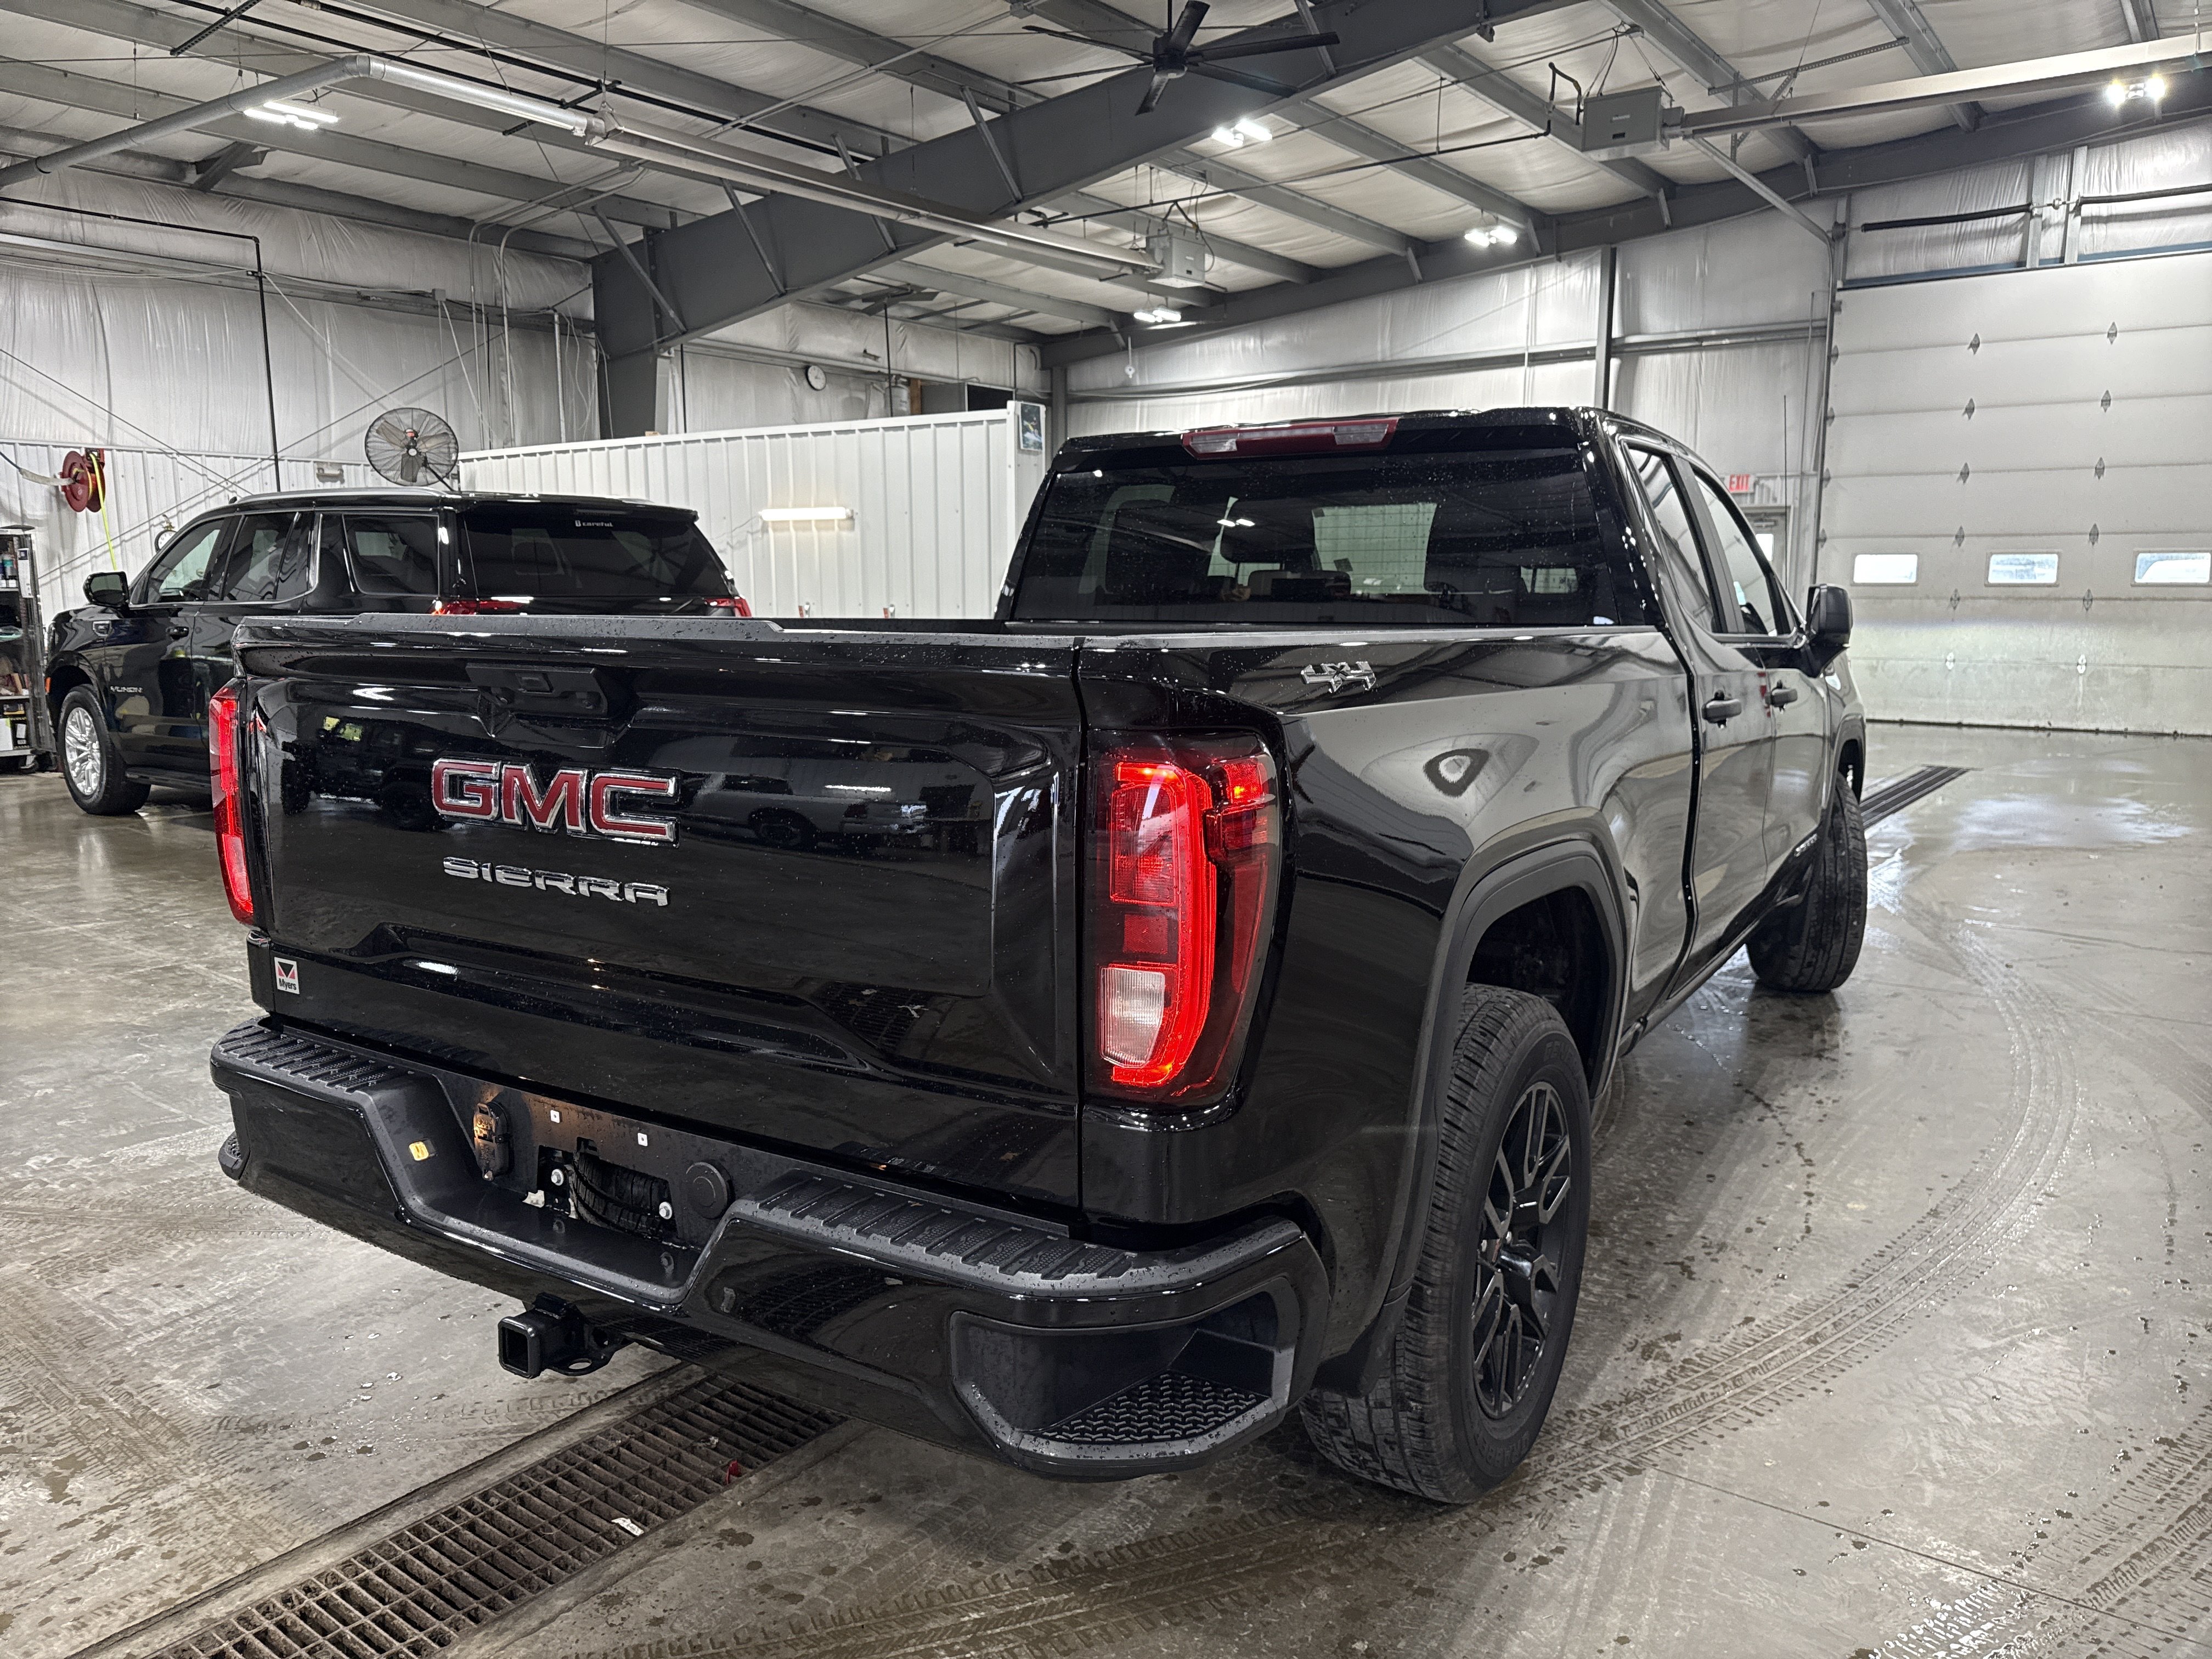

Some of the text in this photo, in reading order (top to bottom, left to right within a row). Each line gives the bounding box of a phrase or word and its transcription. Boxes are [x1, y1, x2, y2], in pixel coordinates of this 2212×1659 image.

[1729, 474, 1751, 492] EXIT
[432, 757, 679, 845] GMC
[443, 856, 670, 906] SIERRA
[279, 978, 297, 990] Myers
